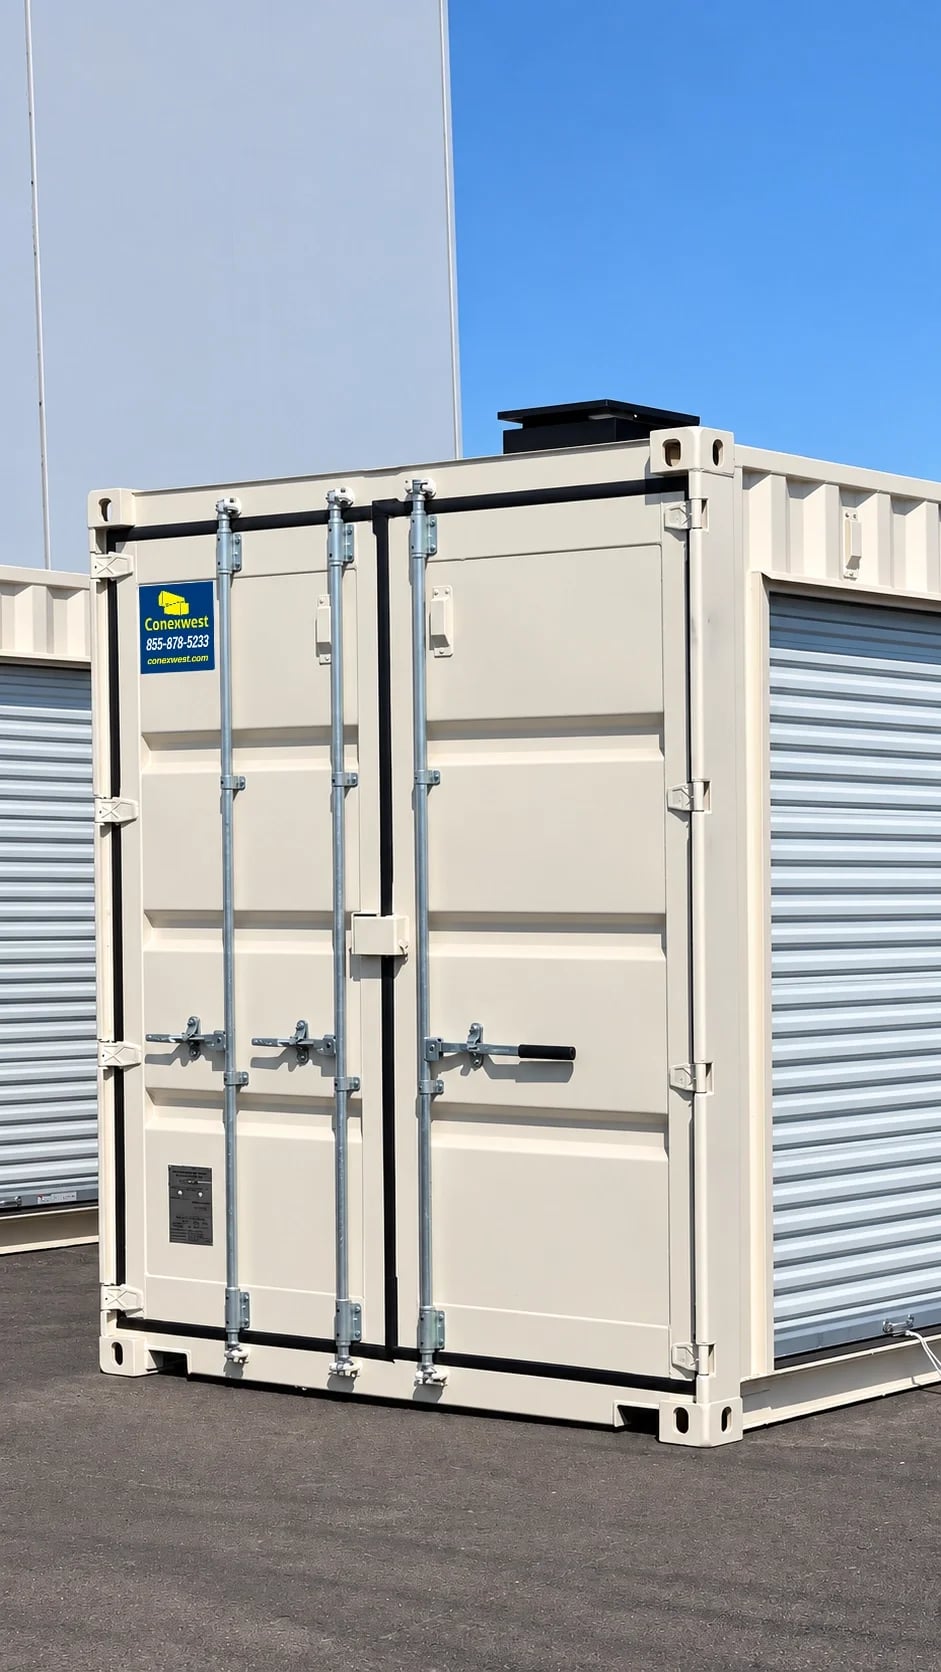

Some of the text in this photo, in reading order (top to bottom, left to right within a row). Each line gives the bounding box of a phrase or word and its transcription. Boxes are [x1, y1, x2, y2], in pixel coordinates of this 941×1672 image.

[144, 616, 209, 631] Conexwest
[146, 634, 209, 651] 855-878-5233
[147, 654, 208, 665] conexwest.com
